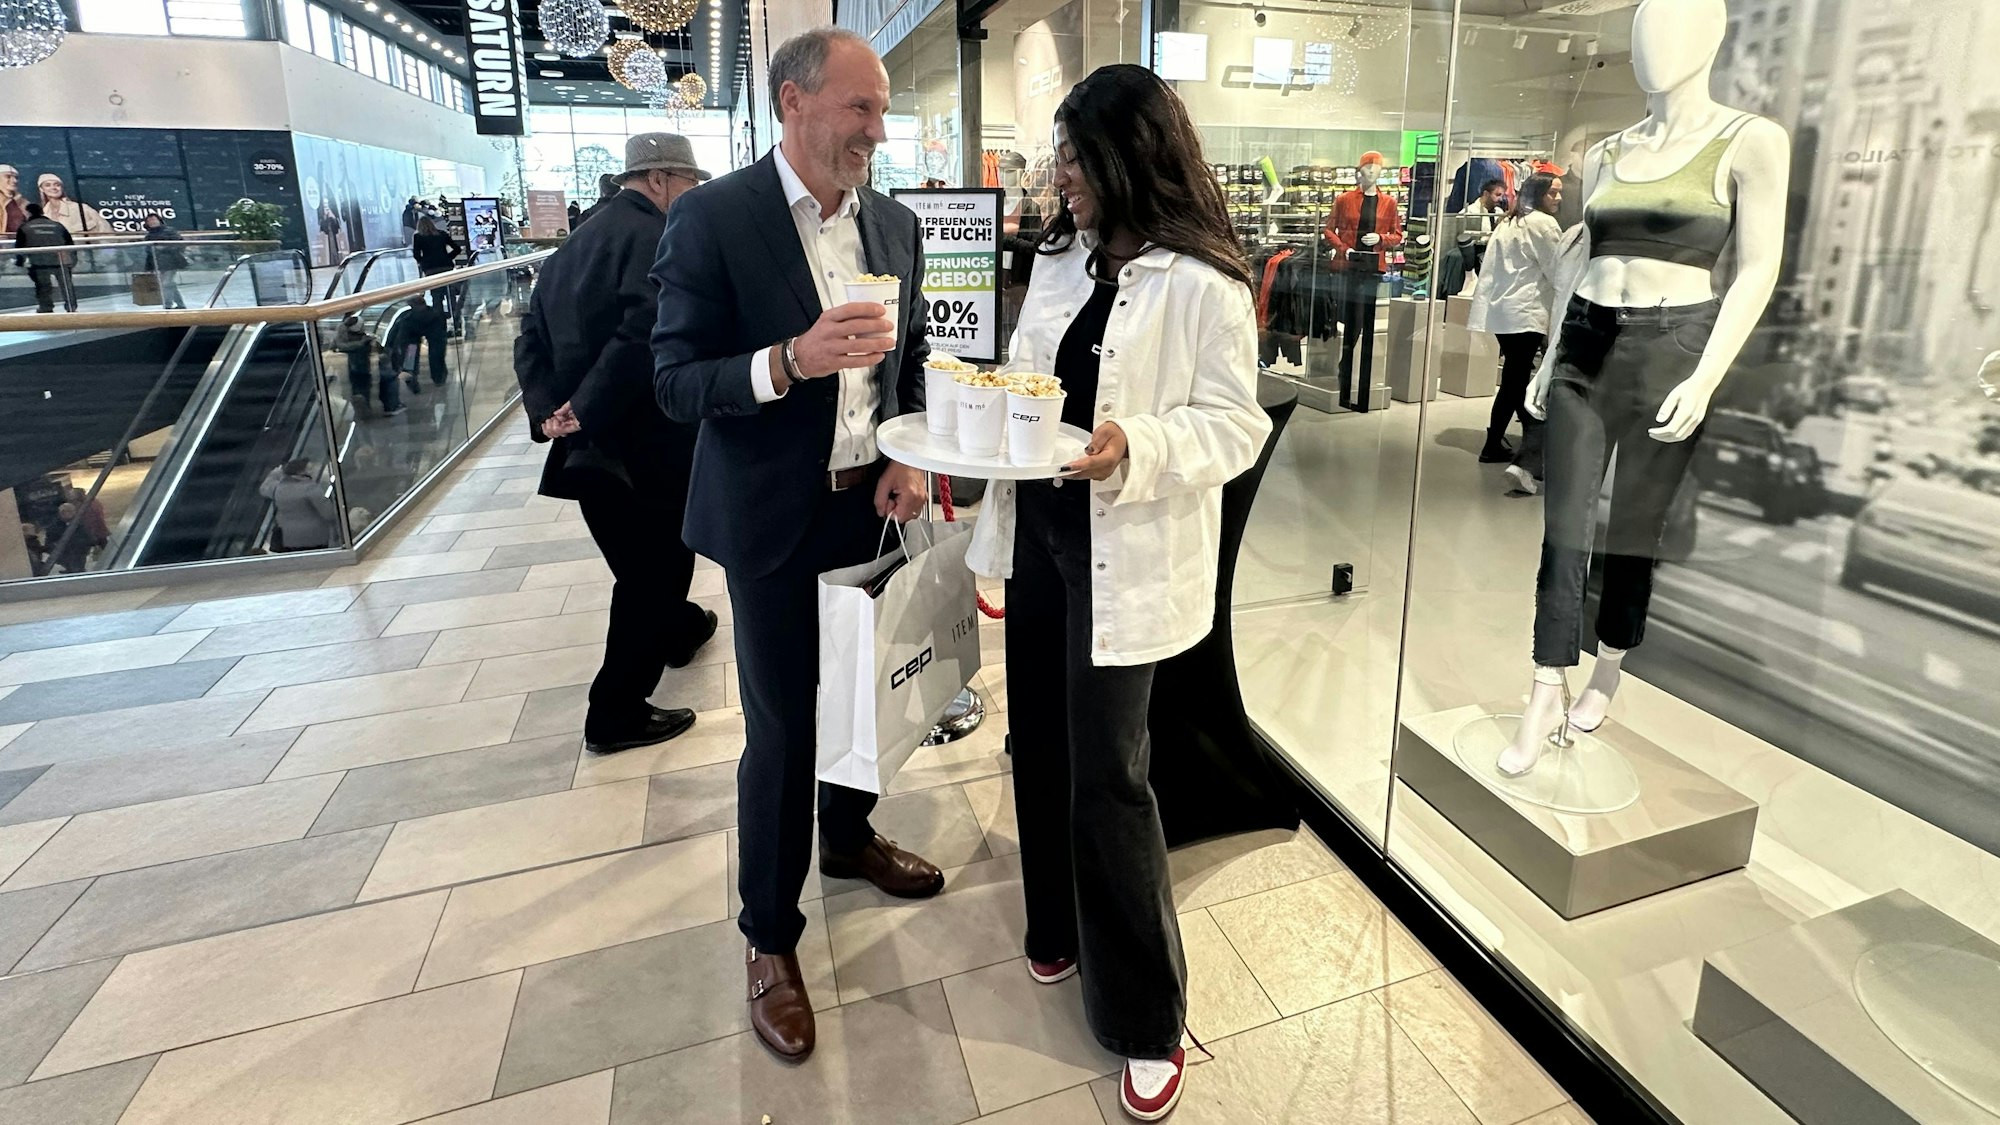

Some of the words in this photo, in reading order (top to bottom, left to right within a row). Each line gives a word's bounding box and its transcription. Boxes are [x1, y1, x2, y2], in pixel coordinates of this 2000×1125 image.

[253, 163, 284, 171] 30-70%
[916, 202, 931, 210] ITEM
[947, 202, 976, 211] cep
[99, 208, 176, 220] COMING
[113, 220, 147, 232] SO
[925, 217, 967, 226] FREUEN
[970, 217, 992, 226] UNS
[940, 228, 992, 241] EUCH!
[925, 256, 994, 269] FFNUNGS-
[925, 325, 979, 339] ABATT
[1012, 412, 1041, 423] cep
[951, 613, 975, 643] ITEM
[890, 646, 932, 690] cep
